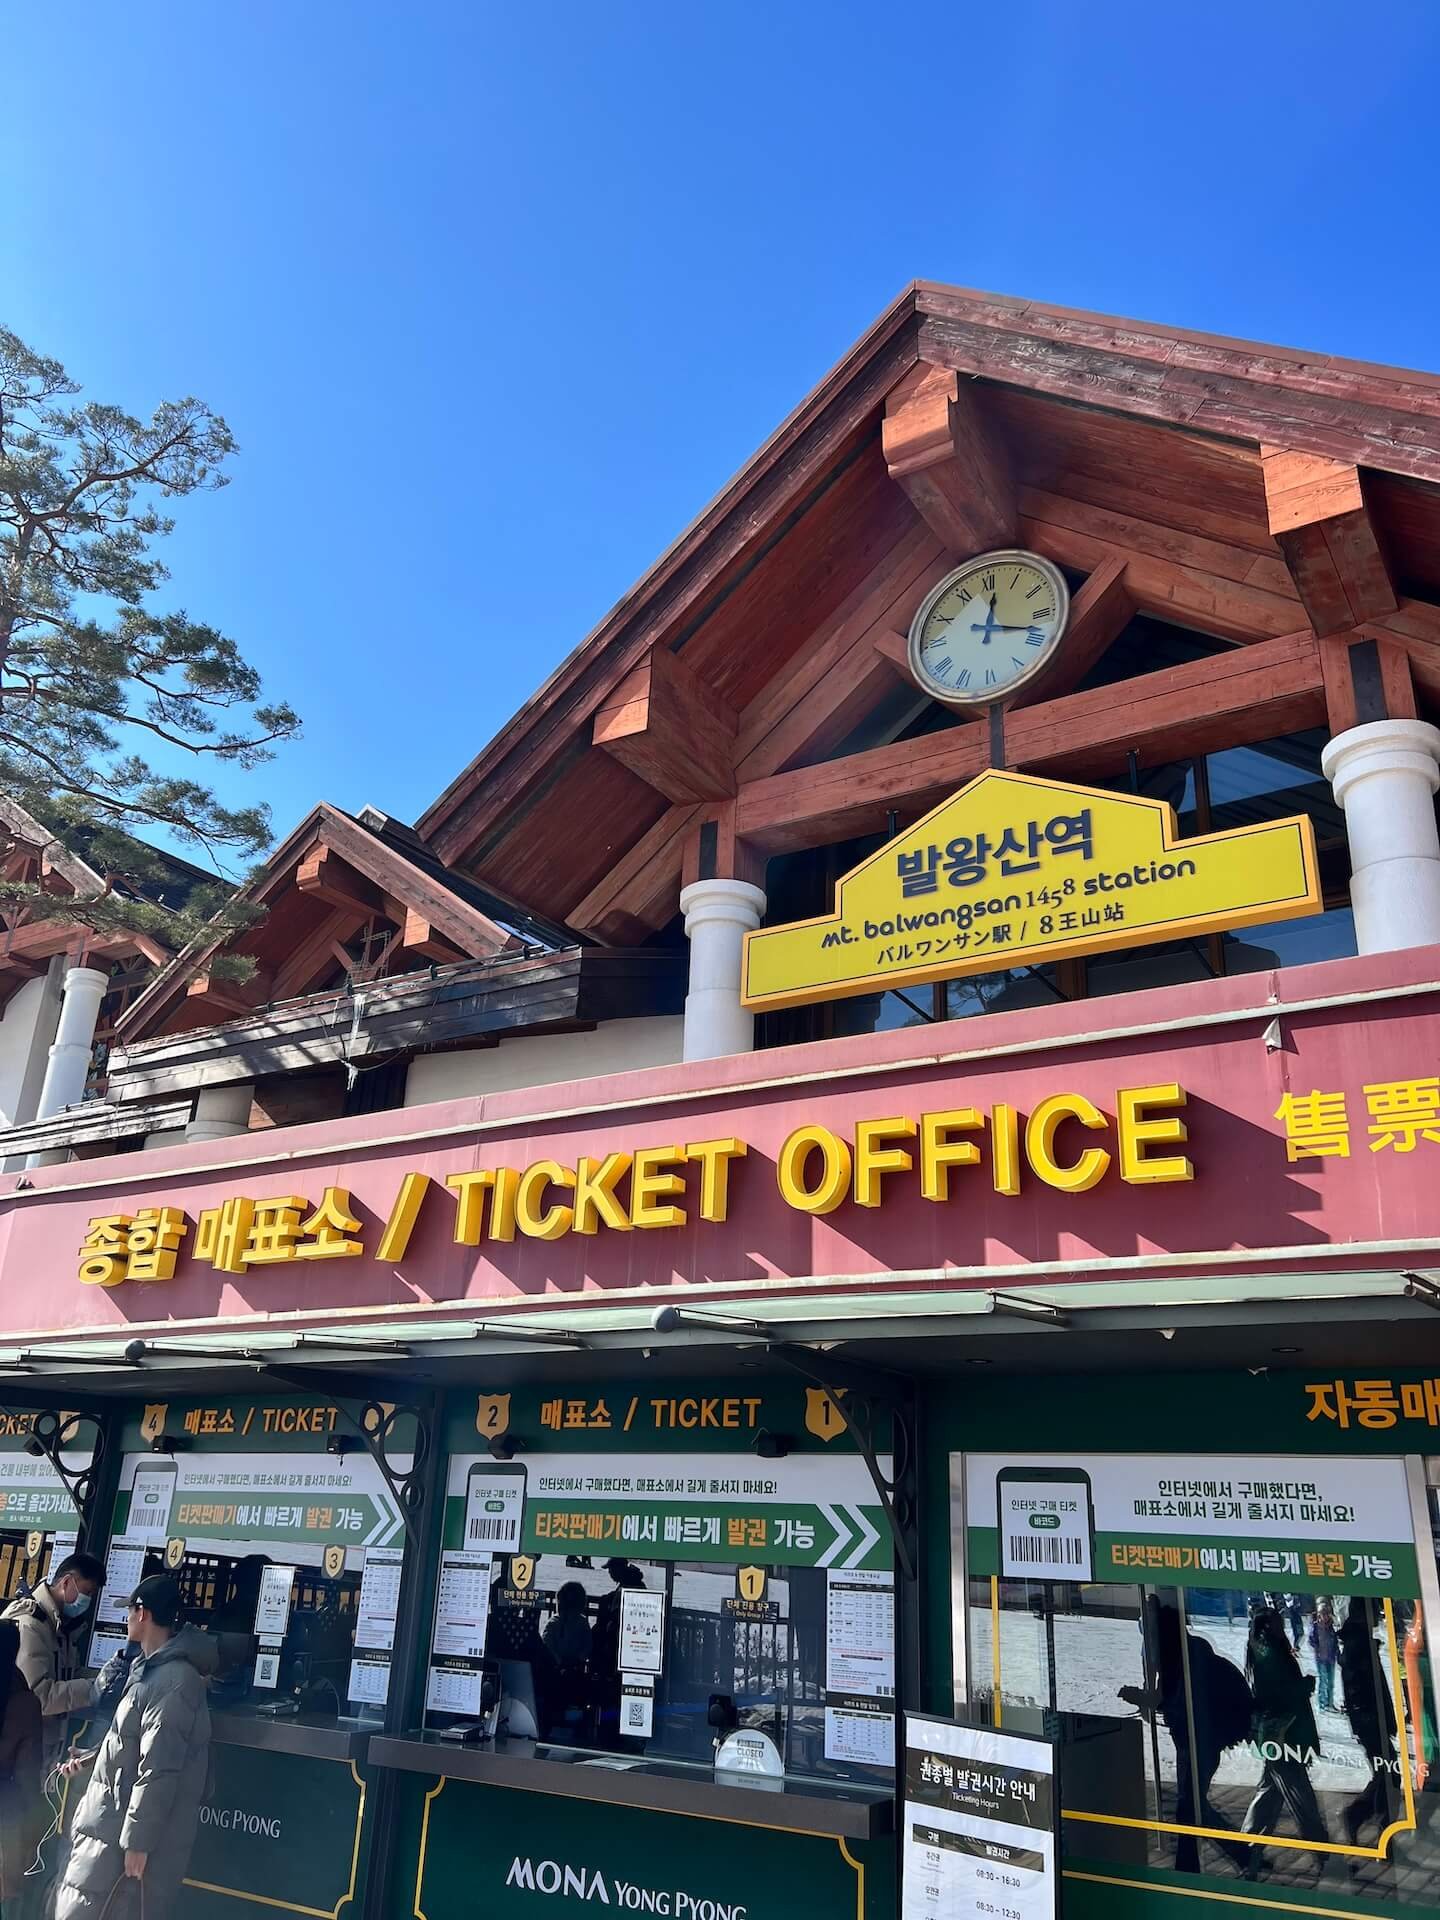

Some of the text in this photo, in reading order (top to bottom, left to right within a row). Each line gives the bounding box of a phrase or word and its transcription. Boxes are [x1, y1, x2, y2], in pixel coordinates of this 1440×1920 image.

[897, 808, 1094, 898] 발왕산역
[864, 894, 1022, 939] balwangsan
[1026, 878, 1076, 909] 1458
[1083, 859, 1196, 896] station
[877, 922, 1013, 966] バルワンサン駅
[1273, 1076, 1440, 1162] 售票
[78, 1081, 1195, 1288] 종합 매표소 / TICKET OFFICE
[148, 1414, 158, 1431] 4
[184, 1406, 338, 1436] 매표소 / TICKET
[487, 1404, 498, 1427] 2
[540, 1396, 762, 1432] 매표소 / TICKET
[821, 1401, 831, 1425] 1
[539, 1477, 777, 1495] 인터넷에서 구매했다면, 매표소에서 길게 줄서지 마세요!
[1157, 1480, 1323, 1502] 인터넷에서 구매했다면,
[178, 1503, 364, 1530] 티켓판매기에서 빠르게 발권 가능
[1011, 1499, 1078, 1512] 인터넷 구매 티켓
[1133, 1499, 1355, 1523] 매표소에서 길게 줄서지 마세요!
[535, 1511, 816, 1549] 티켓판매기에서 빠르게 발권 가능
[30, 1537, 37, 1551] 5
[169, 1546, 178, 1560] 4
[329, 1553, 339, 1569] 3
[516, 1563, 526, 1581] 2
[1111, 1544, 1393, 1580] 티켓판매기에서 빠르게 발권 가능
[746, 1574, 755, 1594] 1
[737, 1748, 764, 1758] CLOSED
[919, 1760, 1036, 1802] 권종별 발권시간 안내
[952, 1792, 999, 1809] Ticketing Hours
[198, 1805, 281, 1838] ONG PYONG
[506, 1857, 610, 1904] MONA
[614, 1880, 670, 1915] YONG
[976, 1868, 994, 1881] 08:30
[1001, 1876, 1021, 1888] 16:30
[976, 1900, 994, 1913] 08:30
[1001, 1908, 1021, 1920] 12:30
